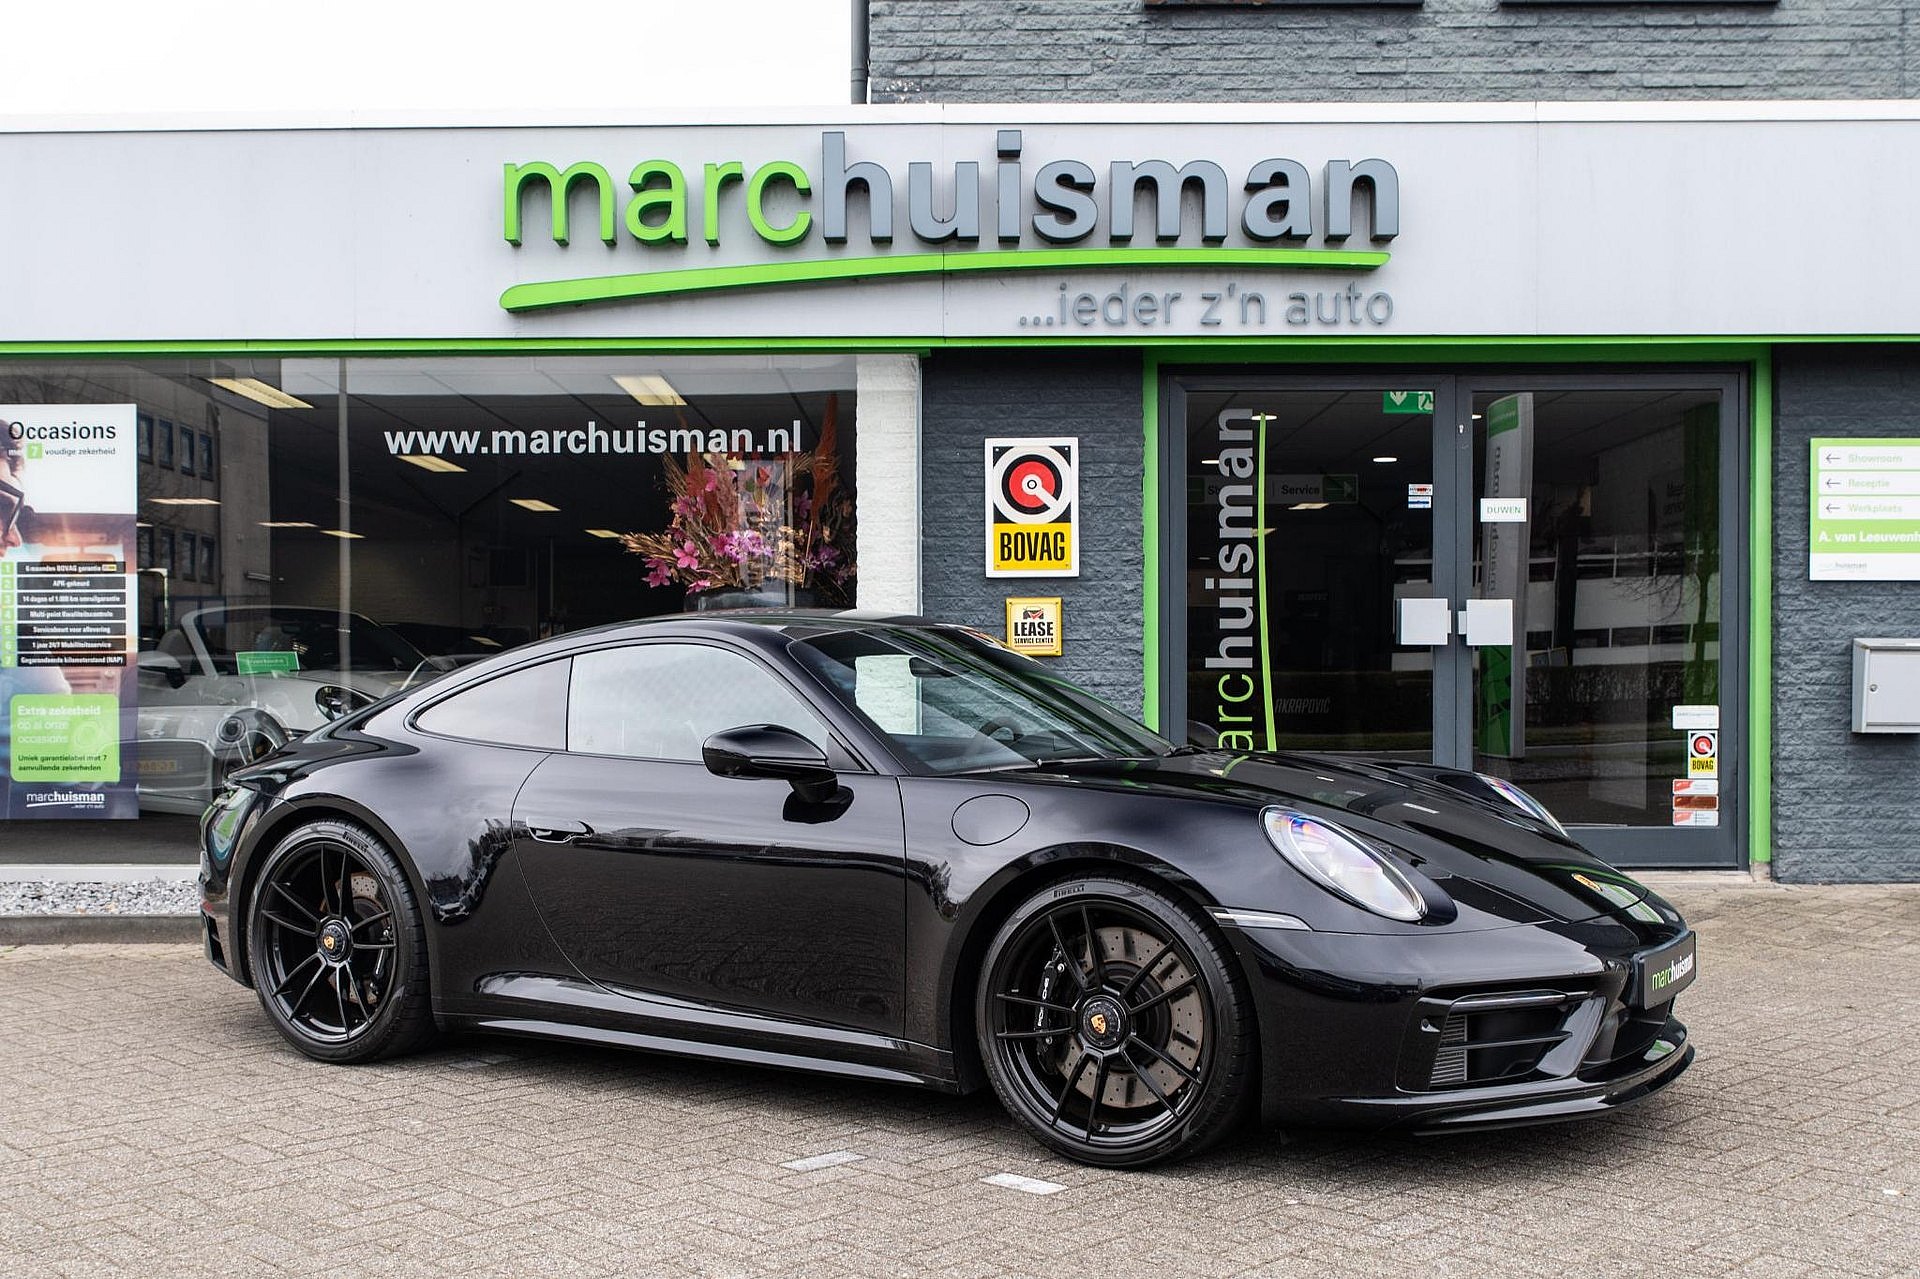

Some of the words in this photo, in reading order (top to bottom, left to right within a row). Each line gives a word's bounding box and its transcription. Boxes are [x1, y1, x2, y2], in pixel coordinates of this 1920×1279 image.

[503, 130, 1400, 247] marchuisman
[1019, 283, 1180, 326] ...ieder
[1200, 284, 1267, 325] z'n
[1285, 285, 1395, 326] auto
[9, 421, 117, 440] Occasions
[383, 419, 802, 456] www.marchuisman.nl
[45, 448, 76, 457] voudige
[78, 448, 117, 456] zekerheid
[1281, 486, 1320, 496] Service
[1818, 530, 1832, 542] A.
[1834, 533, 1856, 542] van
[1000, 532, 1066, 562] BOVAG
[1204, 407, 1255, 752] archuisman
[1014, 622, 1054, 637] LEASE
[18, 705, 47, 716] Extra
[49, 705, 101, 716] zekerheid
[1692, 760, 1714, 770] BOVAG
[26, 790, 105, 803] marchuisman
[1053, 883, 1085, 898] PIRELLI
